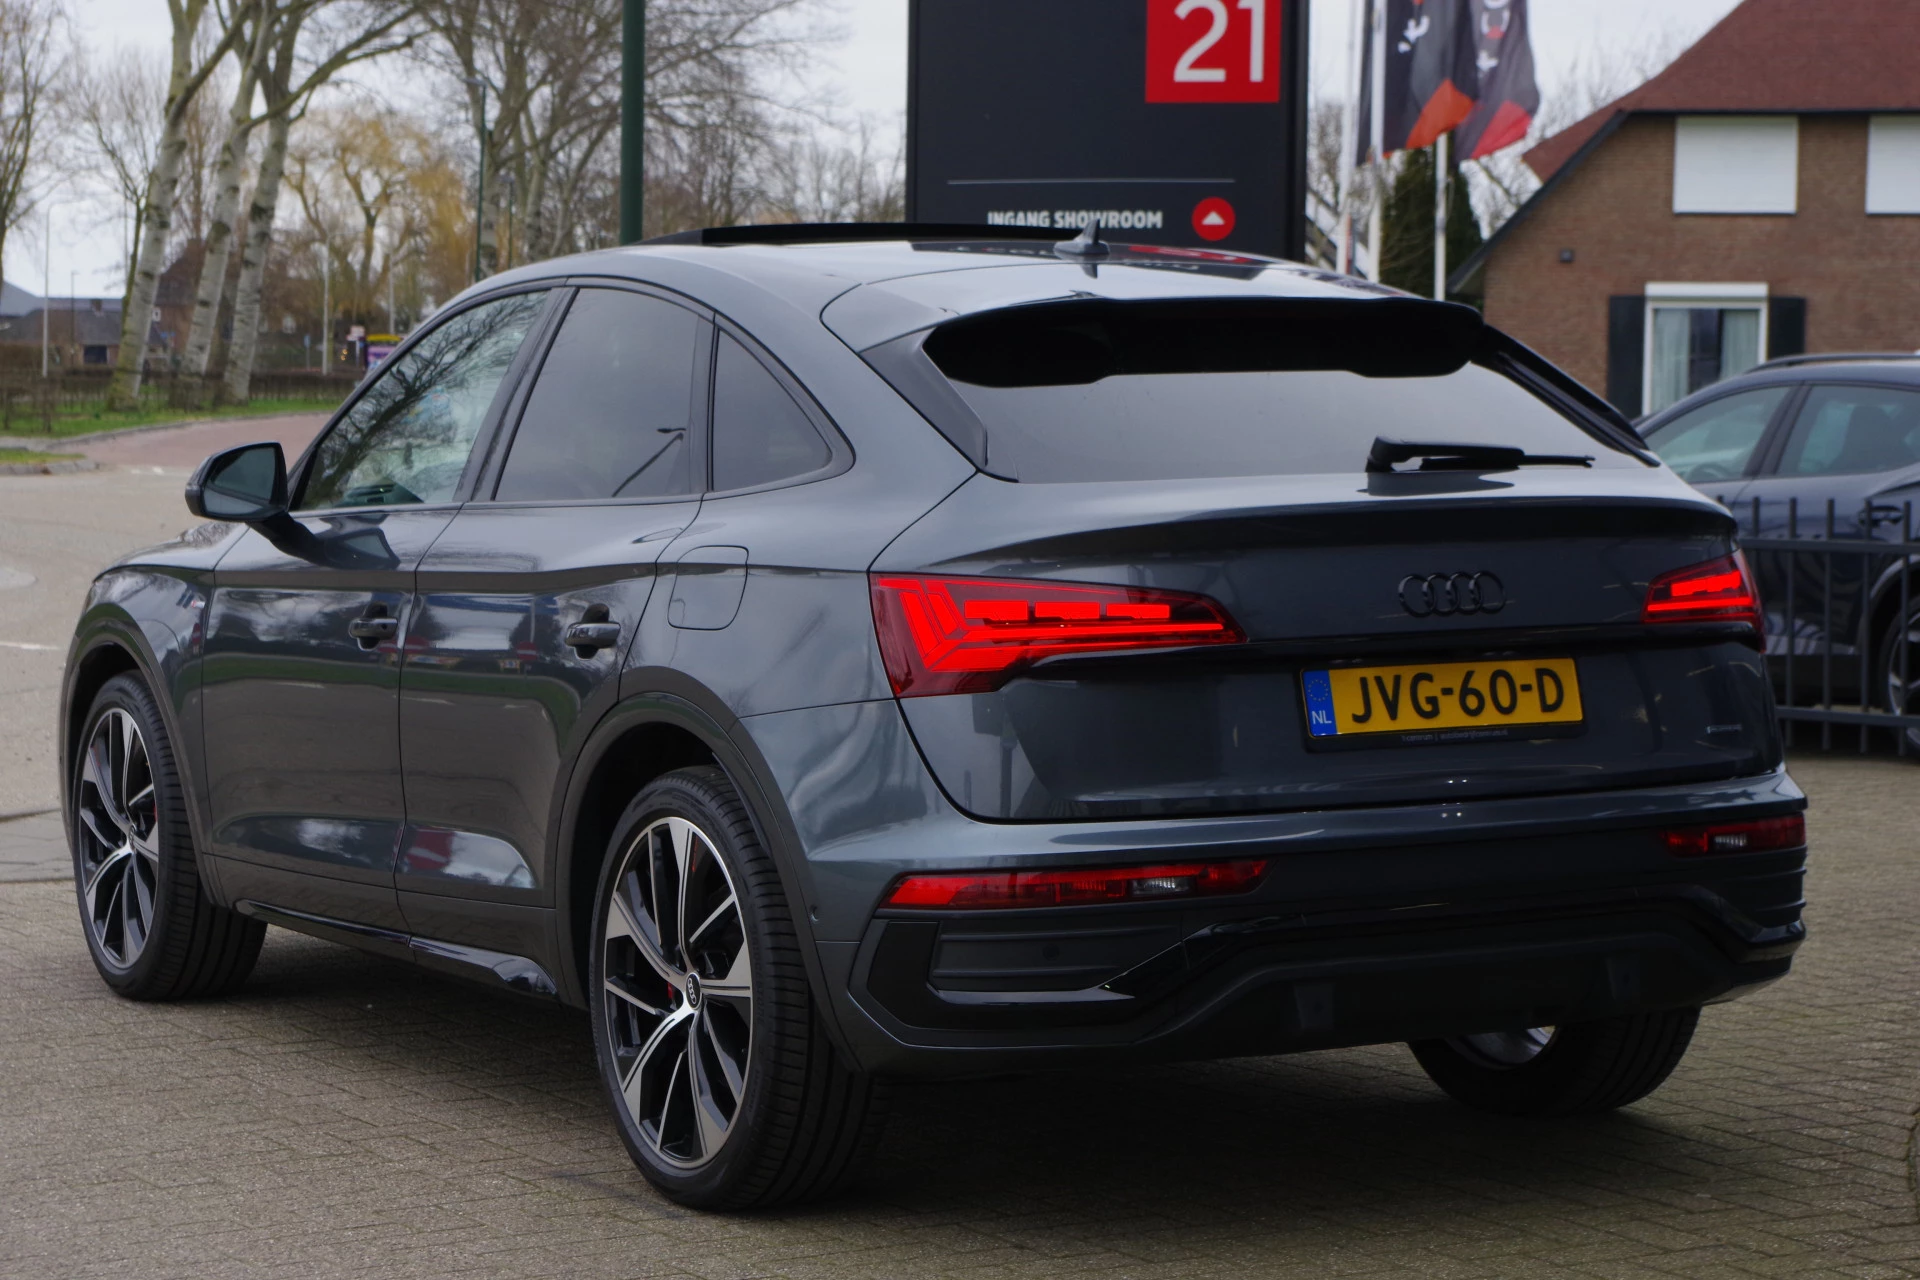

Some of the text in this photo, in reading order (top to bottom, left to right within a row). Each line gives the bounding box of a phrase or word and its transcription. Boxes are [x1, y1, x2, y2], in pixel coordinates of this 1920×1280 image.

[1173, 0, 1265, 82] 21
[987, 211, 1163, 229] INGANG SHOWROOM
[1351, 667, 1564, 724] JVG-60-D
[1311, 710, 1332, 725] NL
